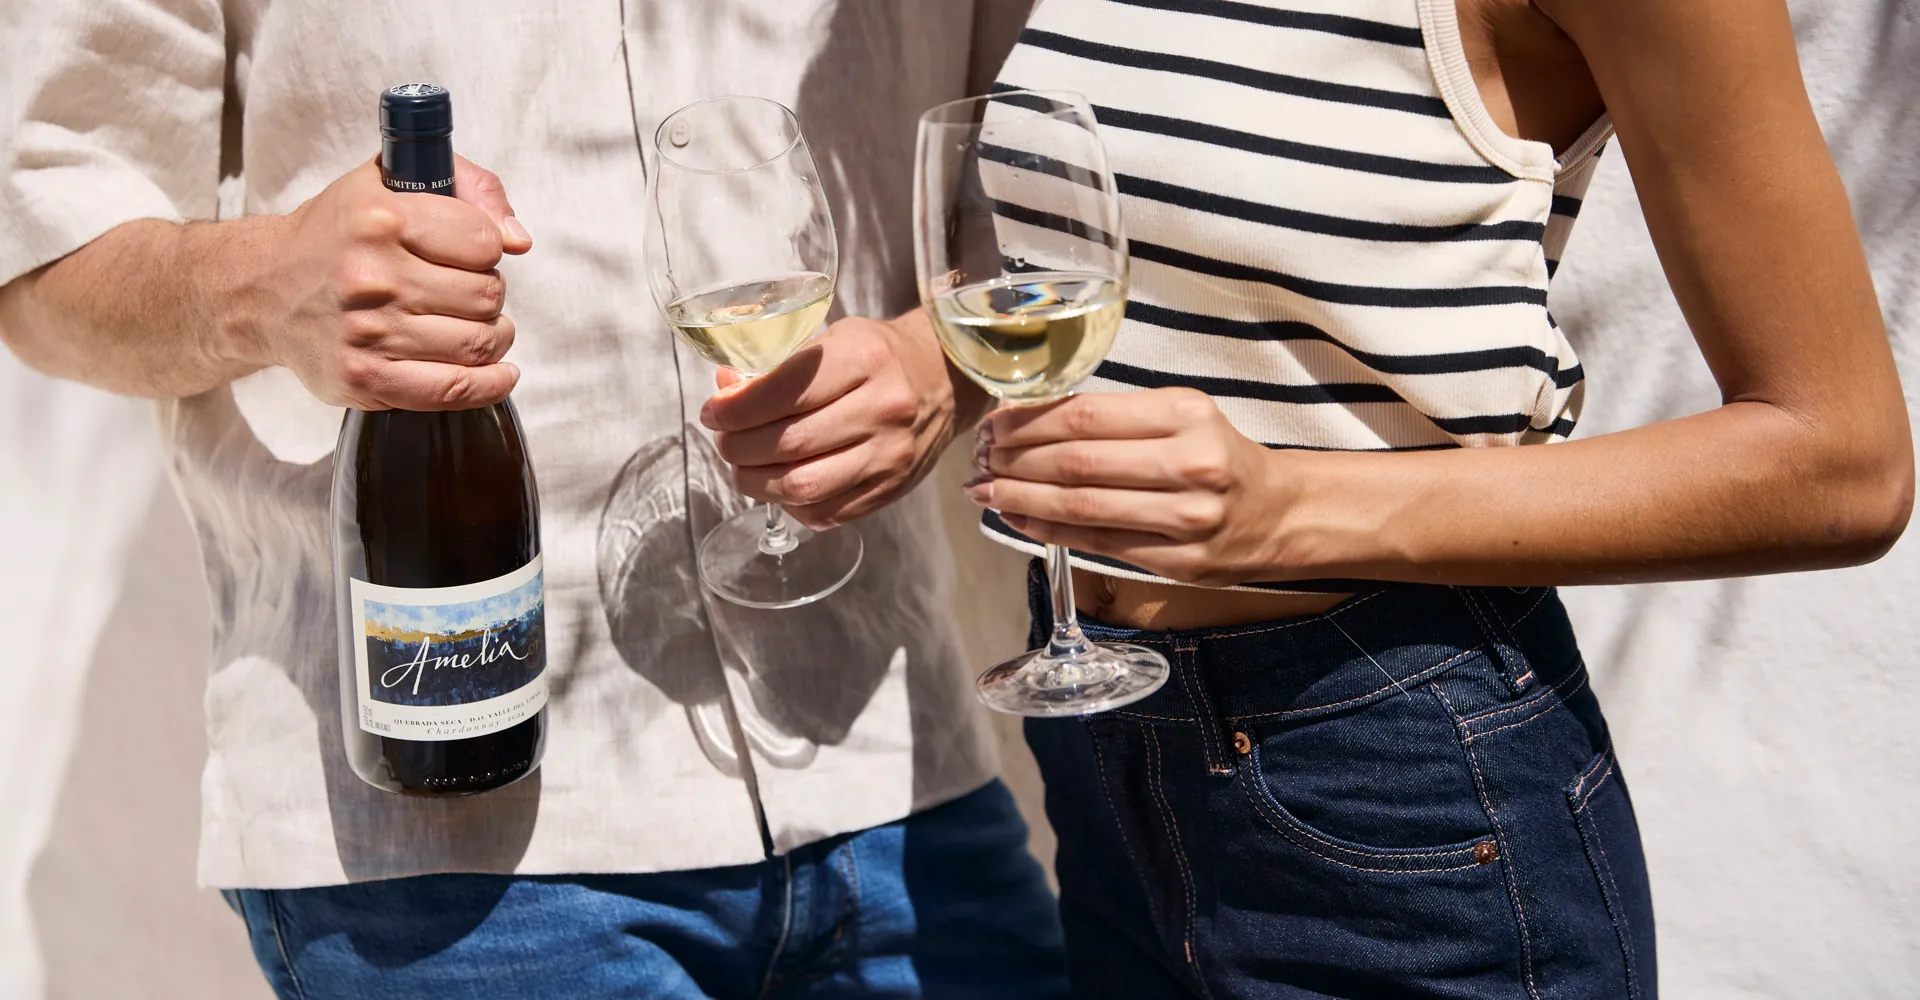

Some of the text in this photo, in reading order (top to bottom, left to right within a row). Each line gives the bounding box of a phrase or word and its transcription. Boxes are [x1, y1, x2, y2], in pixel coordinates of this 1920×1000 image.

[386, 177, 426, 190] LIMITED
[381, 628, 529, 695] Amelia
[393, 718, 438, 727] QUEBRADA
[440, 718, 463, 726] SECA
[488, 708, 511, 719] VALLE
[427, 719, 502, 736] Chardonnay
